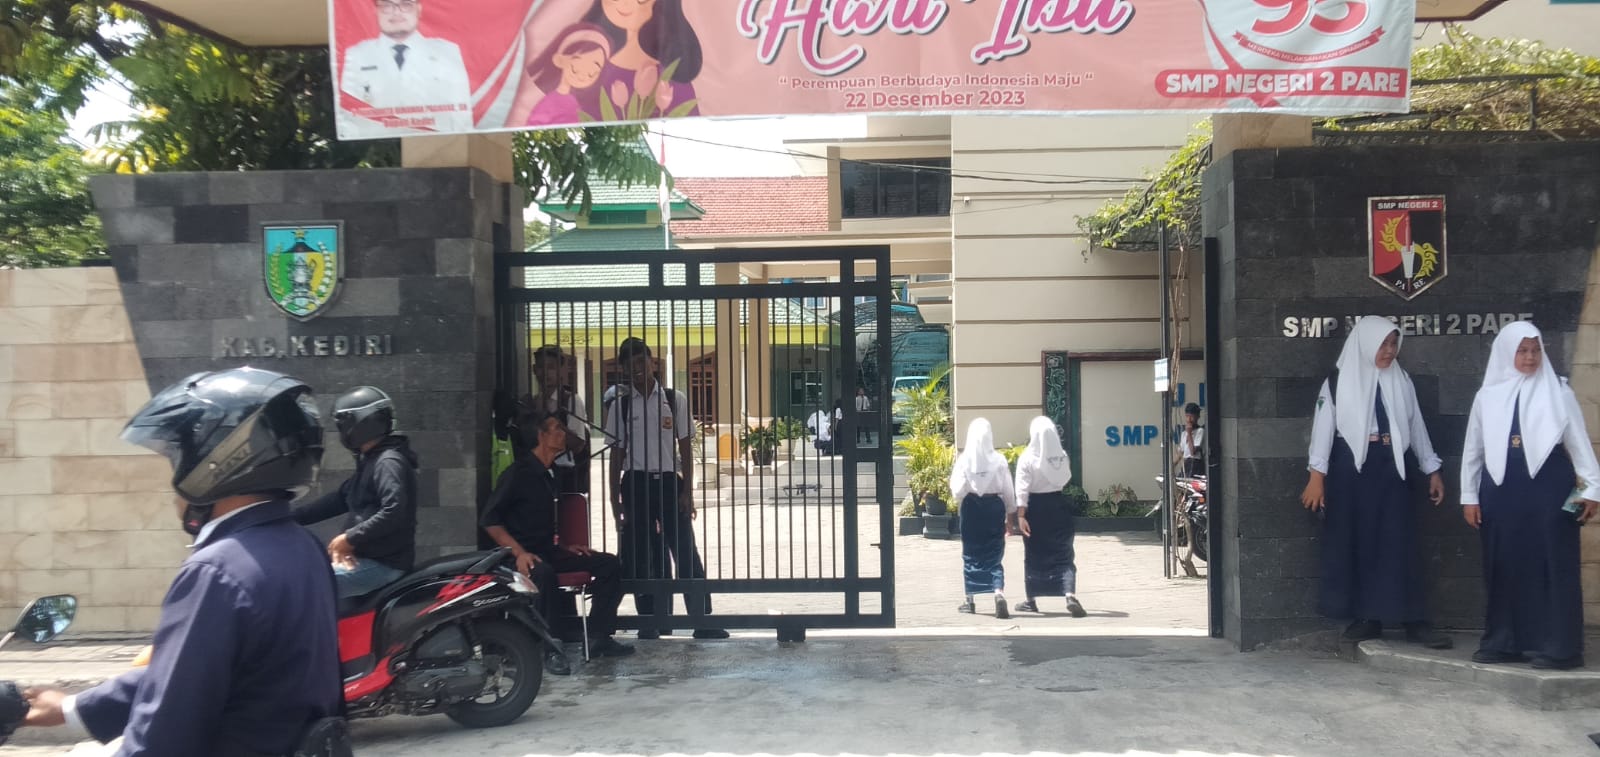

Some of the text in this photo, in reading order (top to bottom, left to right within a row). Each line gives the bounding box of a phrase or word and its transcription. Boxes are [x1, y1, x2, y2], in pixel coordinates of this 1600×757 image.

[792, 77, 876, 90] Perempuan
[880, 75, 960, 88] Berbudaya
[965, 73, 1039, 86] Indonesia
[1044, 73, 1081, 87] Maju
[1166, 71, 1399, 93] SMP NEGERI 2 PARE
[845, 90, 1025, 107] 22 Desember 2023
[1398, 201, 1430, 209] NEGERI
[1283, 316, 1338, 337] SMP
[1446, 313, 1461, 334] 2
[290, 335, 392, 356] KEDIRI
[1105, 425, 1159, 447] SMP
